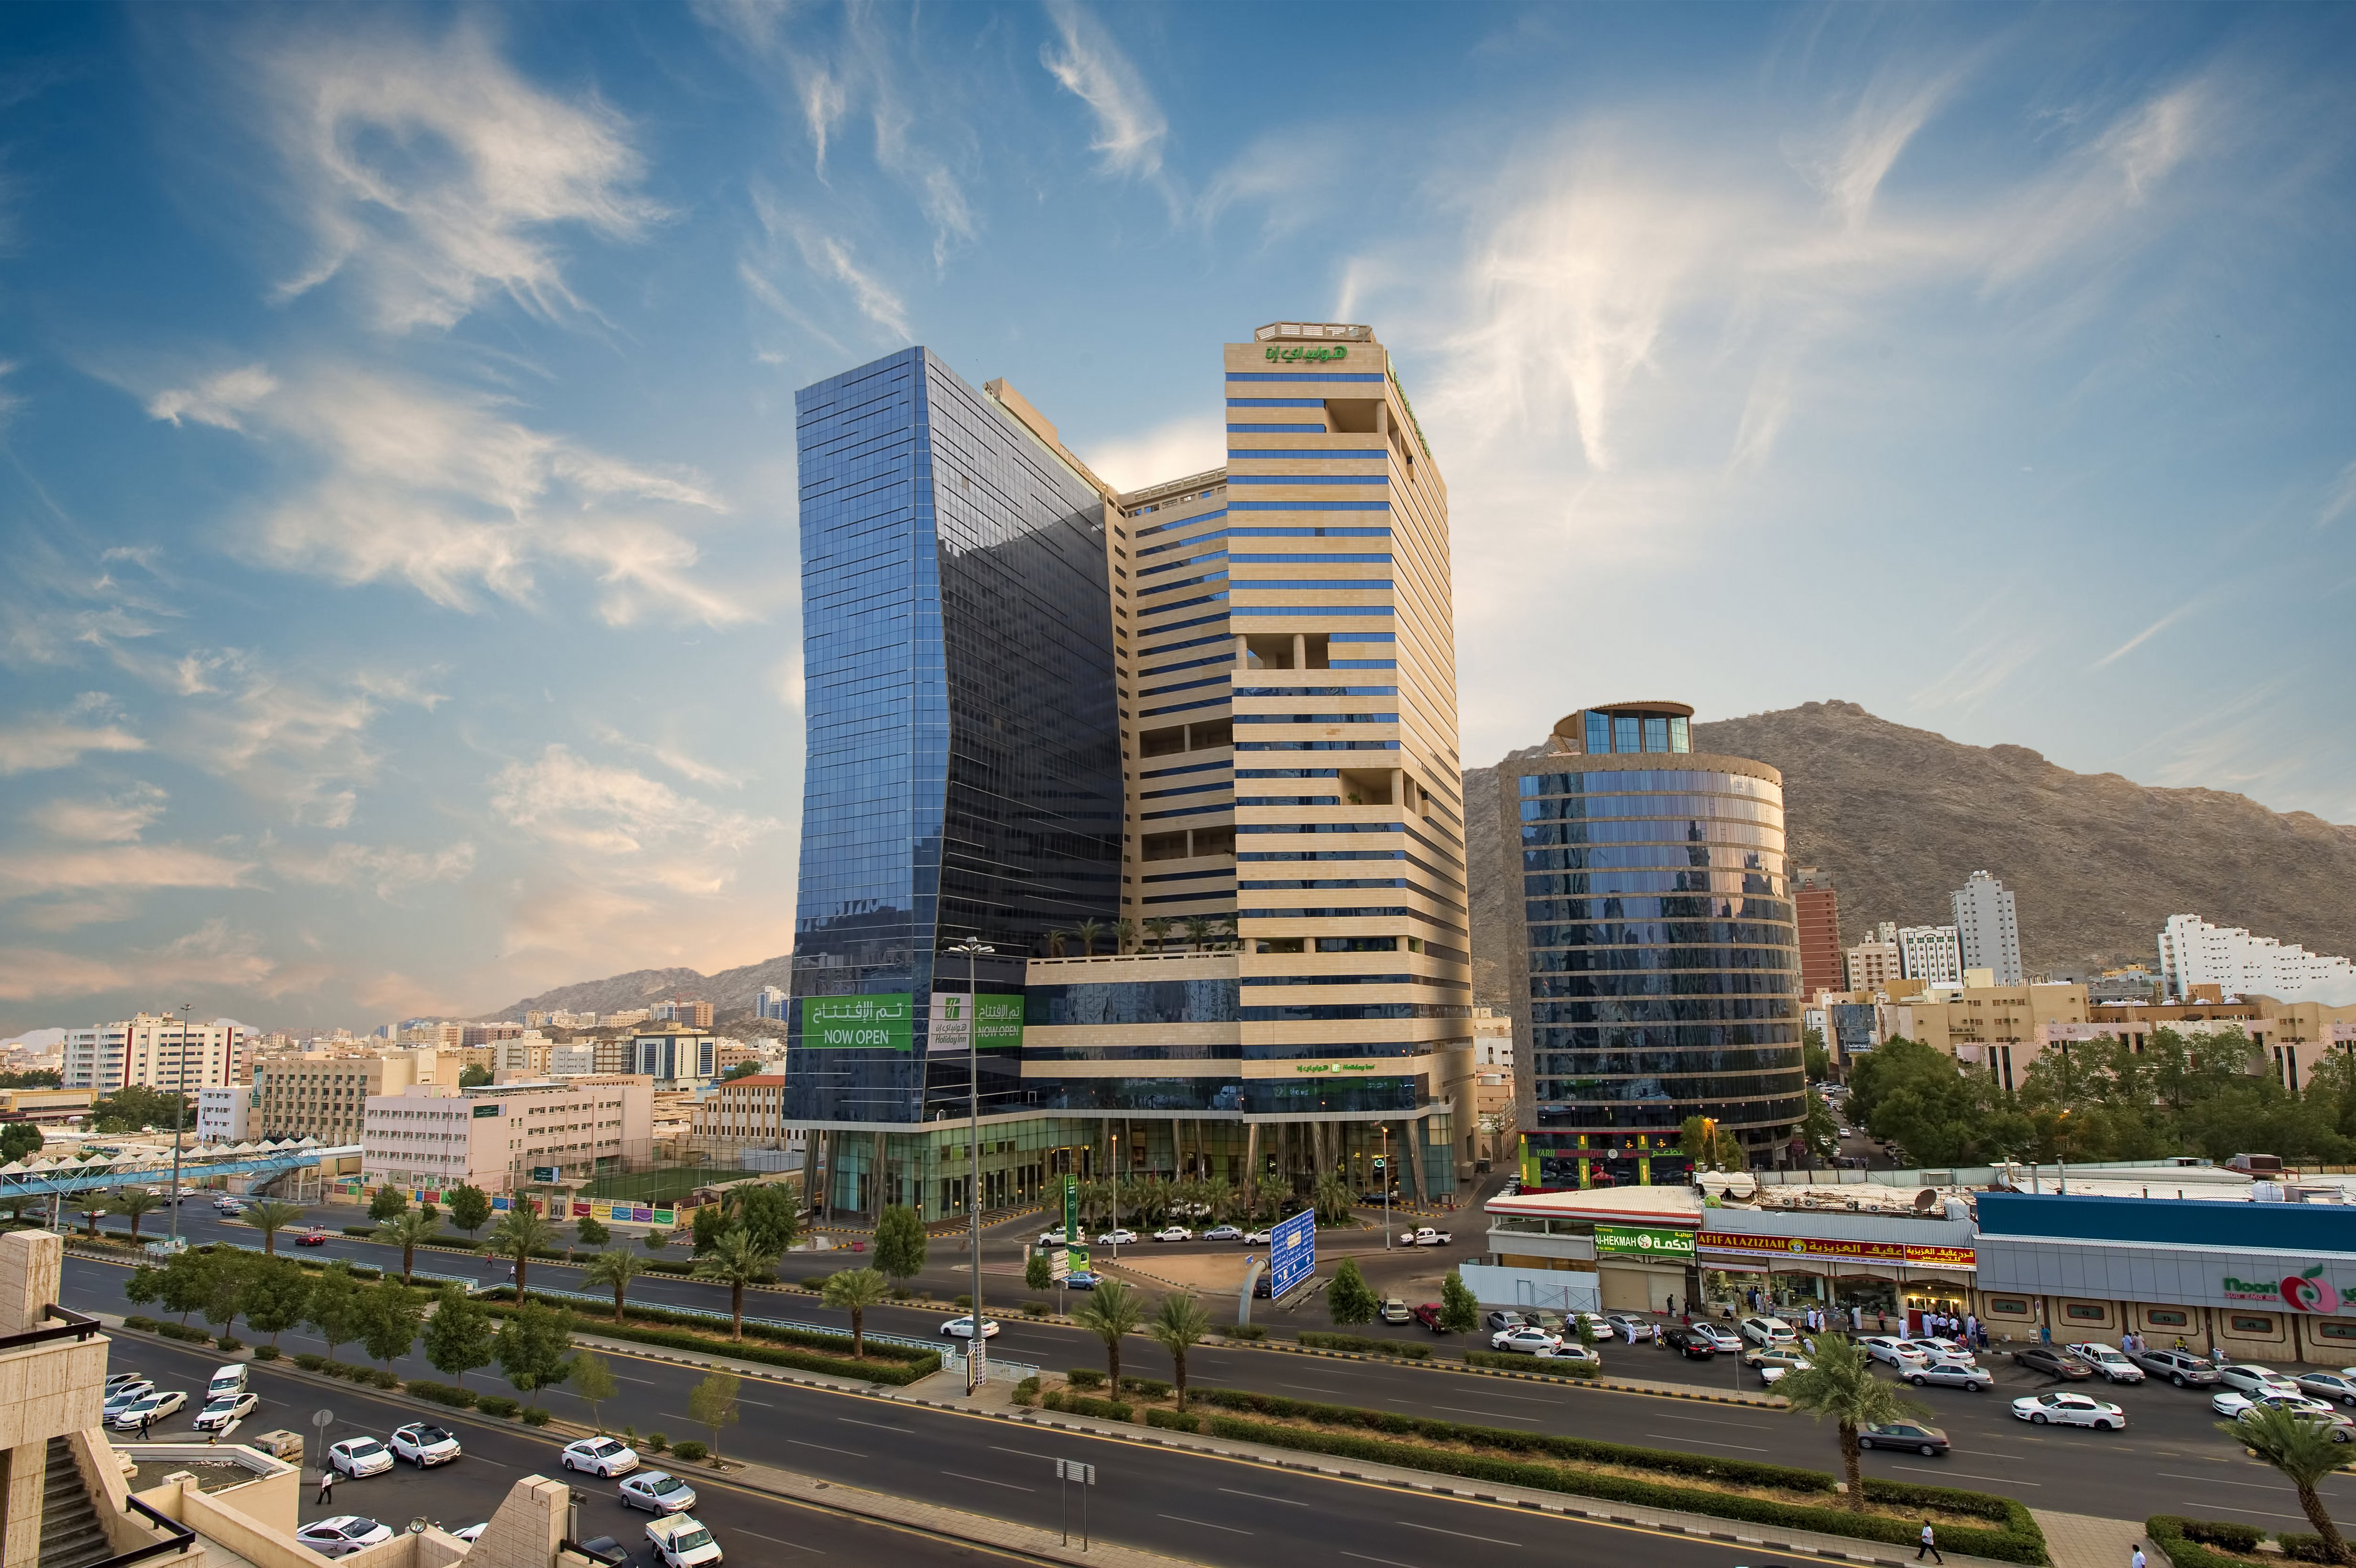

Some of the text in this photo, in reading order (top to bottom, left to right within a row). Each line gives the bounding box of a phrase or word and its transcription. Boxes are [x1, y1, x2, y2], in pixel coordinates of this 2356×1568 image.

[813, 1001, 902, 1024] تم الإفتتاح
[979, 1004, 1020, 1022] تم الإفتتاح
[824, 1030, 889, 1045] NOW OPEN
[978, 1025, 1019, 1037] NOW OPEN
[936, 1034, 957, 1045] Holiday
[1537, 1149, 1555, 1157] YARIJ
[1654, 1237, 1695, 1251] الحكمة
[1809, 1241, 1902, 1256] عفيف العزيزية
[1907, 1247, 1935, 1255] العزيزية
[1937, 1248, 1957, 1257] عفيف
